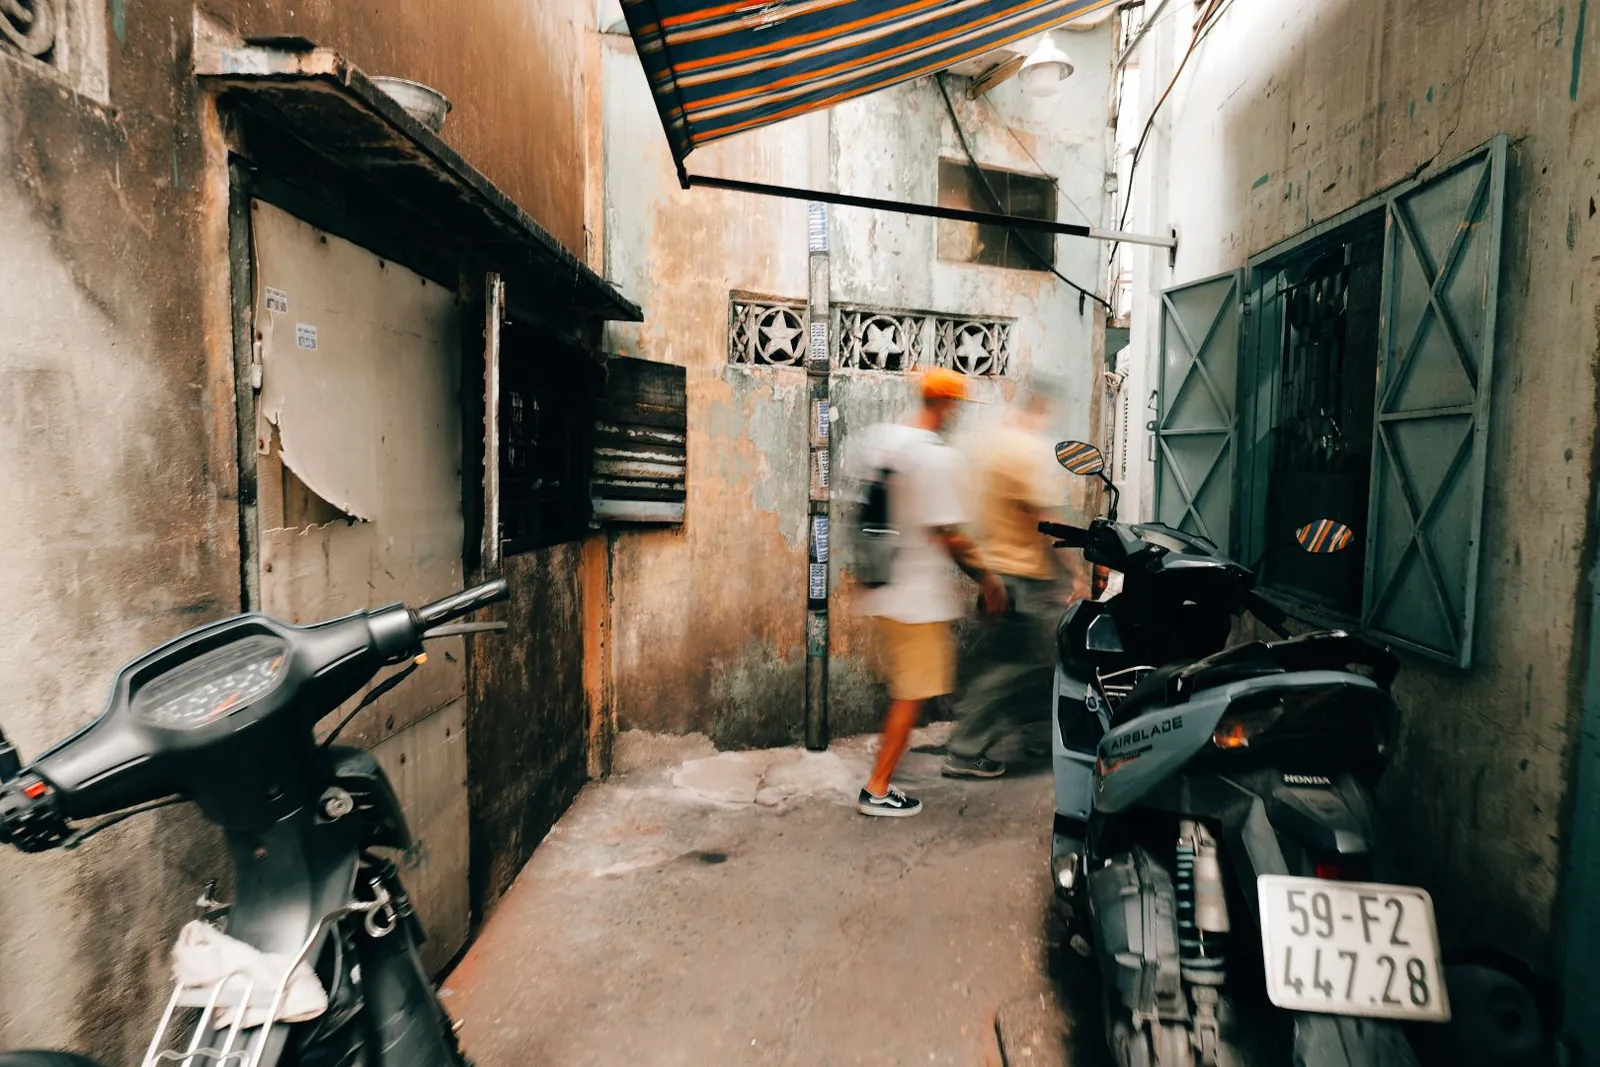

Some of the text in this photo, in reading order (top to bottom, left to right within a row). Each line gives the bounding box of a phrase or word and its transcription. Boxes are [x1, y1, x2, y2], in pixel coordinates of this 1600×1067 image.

[1111, 715, 1183, 750] AIRBLADE
[1284, 774, 1332, 785] HONDA
[1286, 890, 1410, 947] 59-F2
[1284, 947, 1430, 1007] 447.28
